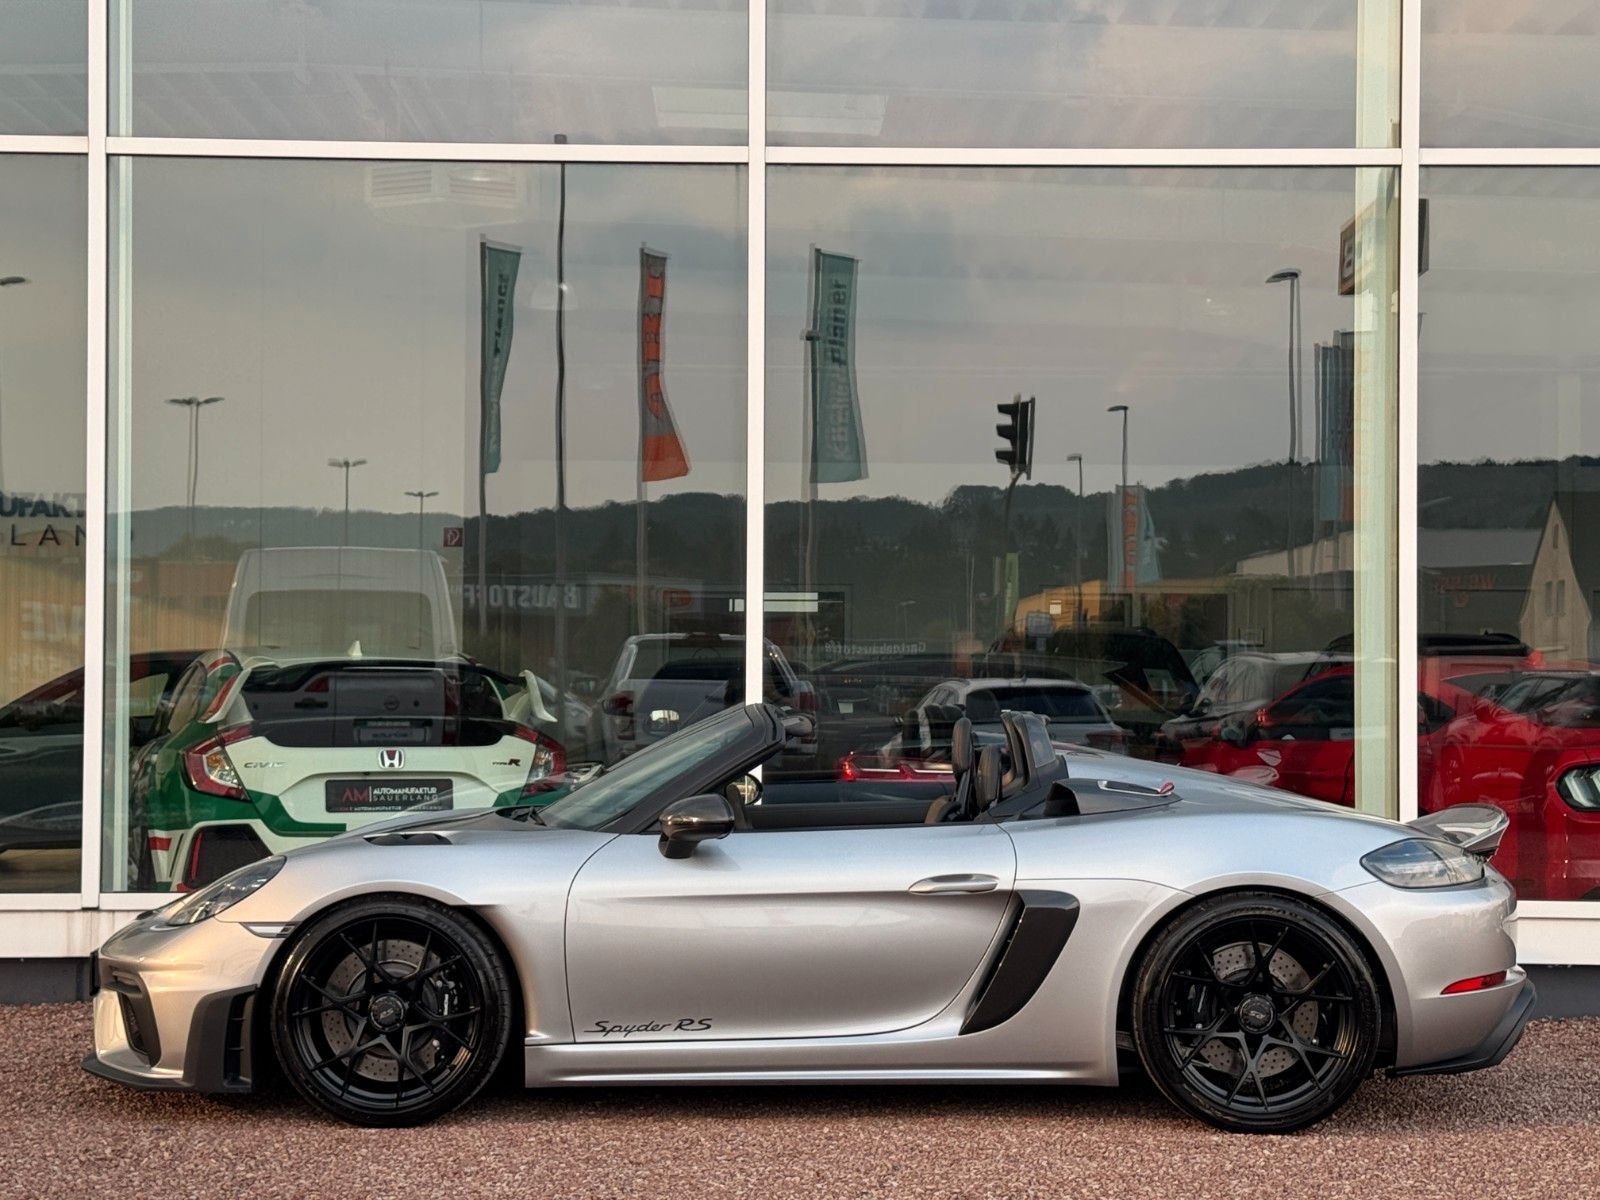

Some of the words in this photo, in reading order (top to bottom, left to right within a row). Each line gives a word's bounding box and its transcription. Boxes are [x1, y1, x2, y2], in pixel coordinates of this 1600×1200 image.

[10, 524, 87, 546] LAN
[584, 1020, 672, 1038] Spyder
[674, 1018, 713, 1031] RS
